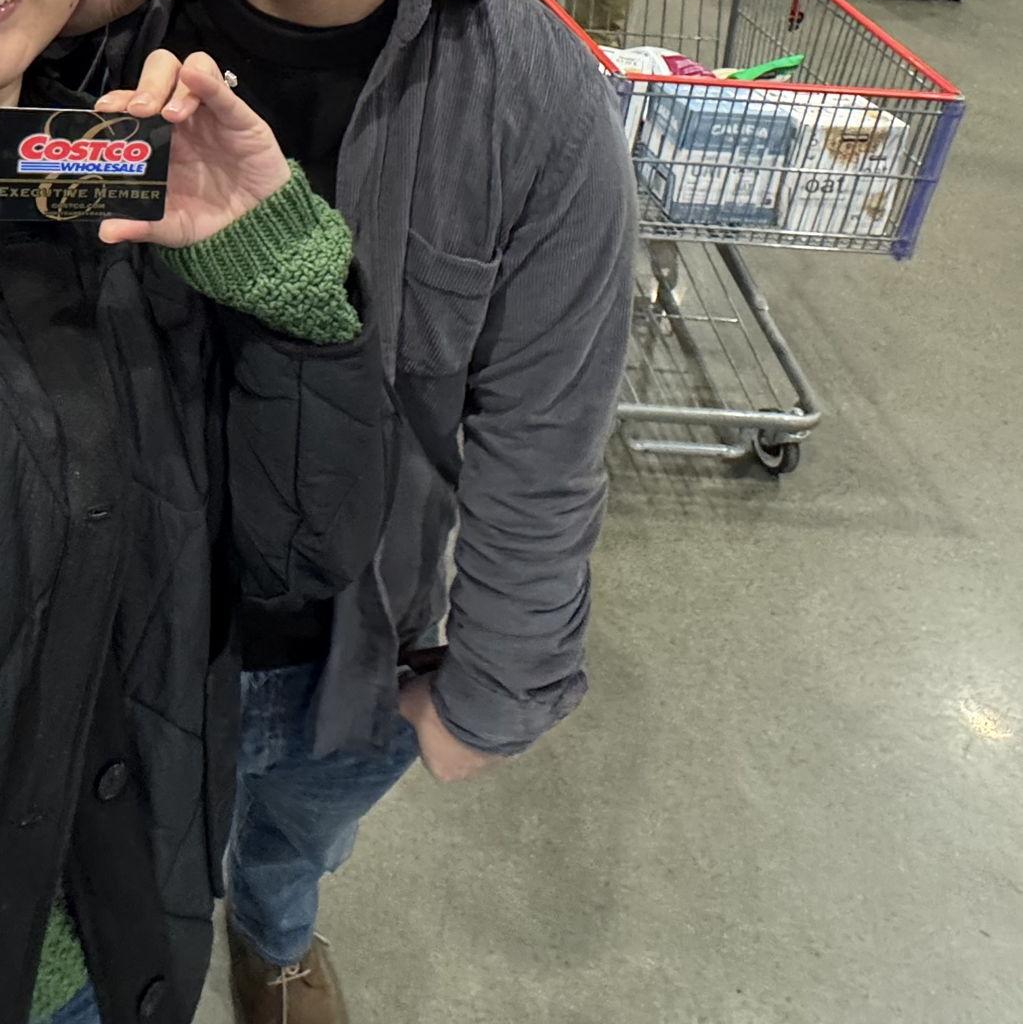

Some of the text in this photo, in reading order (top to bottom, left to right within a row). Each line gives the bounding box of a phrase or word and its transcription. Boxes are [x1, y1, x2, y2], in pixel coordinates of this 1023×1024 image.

[19, 134, 151, 162] COSTCO
[60, 163, 145, 173] WHOLESALE
[94, 187, 160, 200] MEMBER
